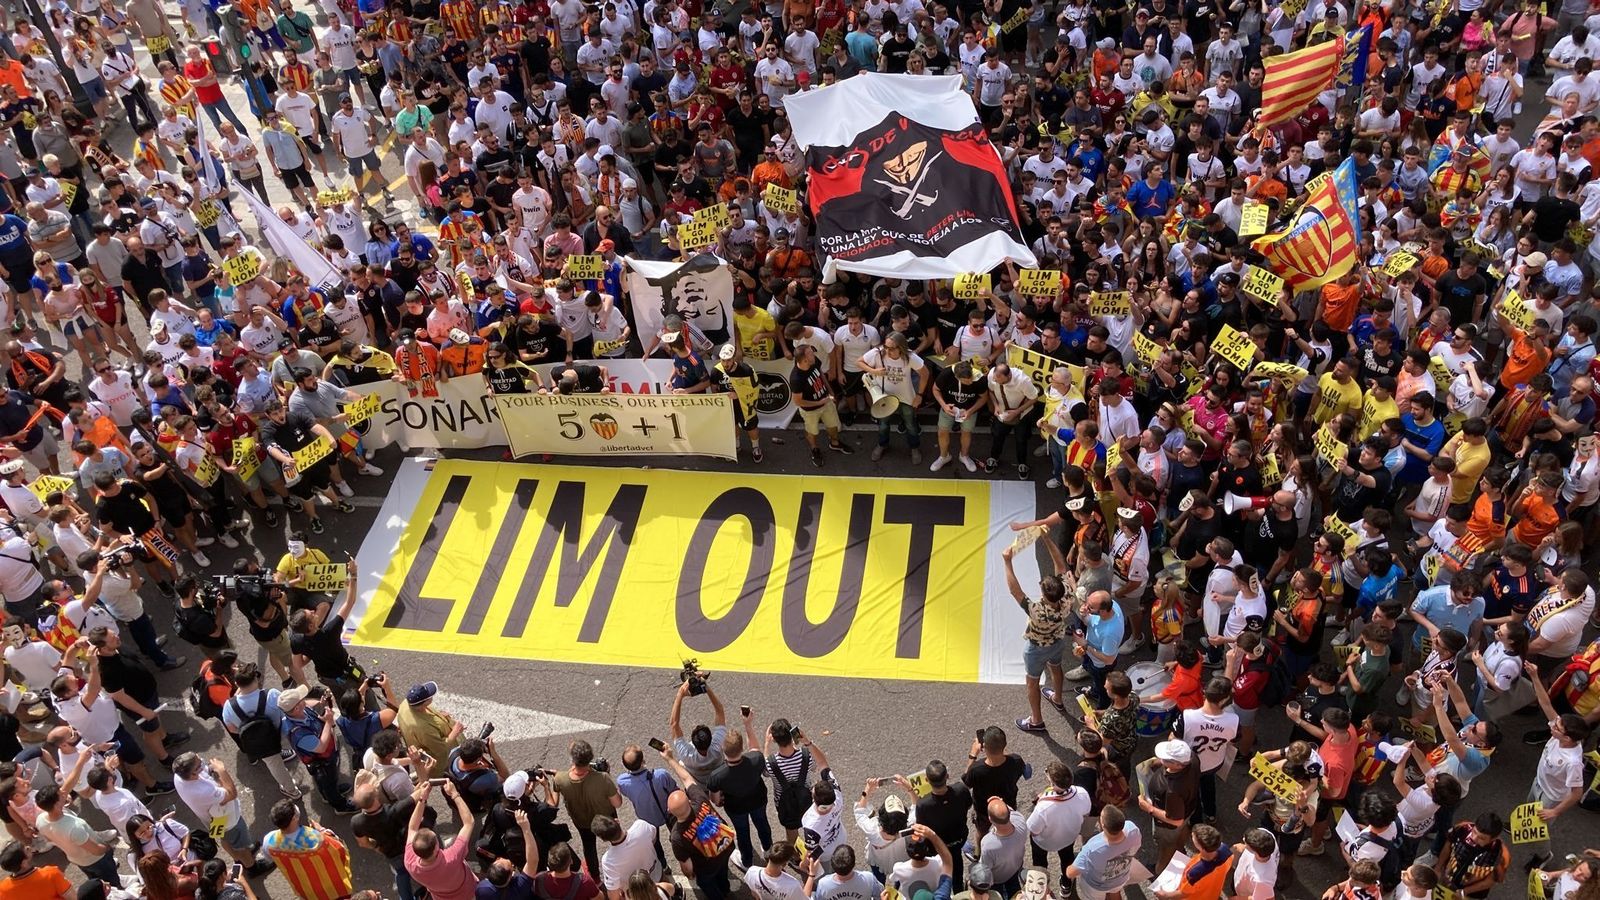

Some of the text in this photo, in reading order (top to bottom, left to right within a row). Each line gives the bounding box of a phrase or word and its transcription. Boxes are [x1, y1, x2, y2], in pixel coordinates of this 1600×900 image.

[870, 128, 896, 152] DE
[65, 186, 76, 207] OME
[772, 186, 790, 197] LIM
[701, 206, 720, 218] LIM
[766, 199, 796, 212] HOME
[1242, 204, 1251, 234] HOME
[1251, 212, 1256, 223] GO
[1258, 206, 1266, 226] LIM
[686, 222, 706, 232] LIM
[820, 236, 842, 246] POR
[846, 233, 859, 242] LA
[927, 214, 954, 238] PETER
[683, 234, 715, 248] HOME
[832, 244, 854, 253] UNA
[858, 234, 876, 246] LEY
[952, 222, 958, 230] A
[230, 254, 250, 269] LIM
[232, 266, 260, 286] HOME
[570, 270, 603, 279] HOME
[963, 274, 983, 283] LIM
[1028, 271, 1052, 280] LIM
[1256, 269, 1277, 284] LIM
[956, 290, 984, 298] HOM
[1020, 286, 1057, 296] HOME
[1098, 292, 1122, 301] LIM
[1246, 283, 1276, 303] HOME
[1092, 306, 1130, 315] HOME
[1511, 296, 1527, 314] LIM
[1502, 308, 1530, 330] HOME
[1512, 308, 1522, 318] GO
[598, 342, 616, 350] LIM
[1137, 334, 1154, 351] LIM
[1228, 331, 1250, 348] LIM
[1230, 342, 1241, 351] GO
[1139, 346, 1146, 354] GO
[1214, 341, 1246, 368] HOME
[1022, 350, 1069, 373] LIM
[1324, 386, 1341, 401] LIM
[352, 394, 370, 409] LIM
[357, 404, 366, 412] GO
[503, 396, 725, 408] YOUR BUSINESS, OUR FEELING
[380, 394, 500, 432] SOÑAR
[1365, 401, 1376, 418] LIM
[558, 410, 586, 441] 5
[1322, 429, 1338, 449] LIM
[302, 439, 322, 457] LIM
[308, 450, 319, 458] GO
[46, 482, 56, 492] GO
[1332, 518, 1353, 539] LIM
[151, 536, 178, 562] VALENC
[314, 566, 338, 574] LIM
[383, 475, 966, 658] LIM OUT
[308, 582, 344, 590] HOME
[1200, 724, 1224, 732] AARON
[1252, 768, 1296, 802] HOME
[1517, 805, 1534, 818] LIM
[1522, 818, 1532, 827] GO
[1514, 827, 1545, 840] HOME
